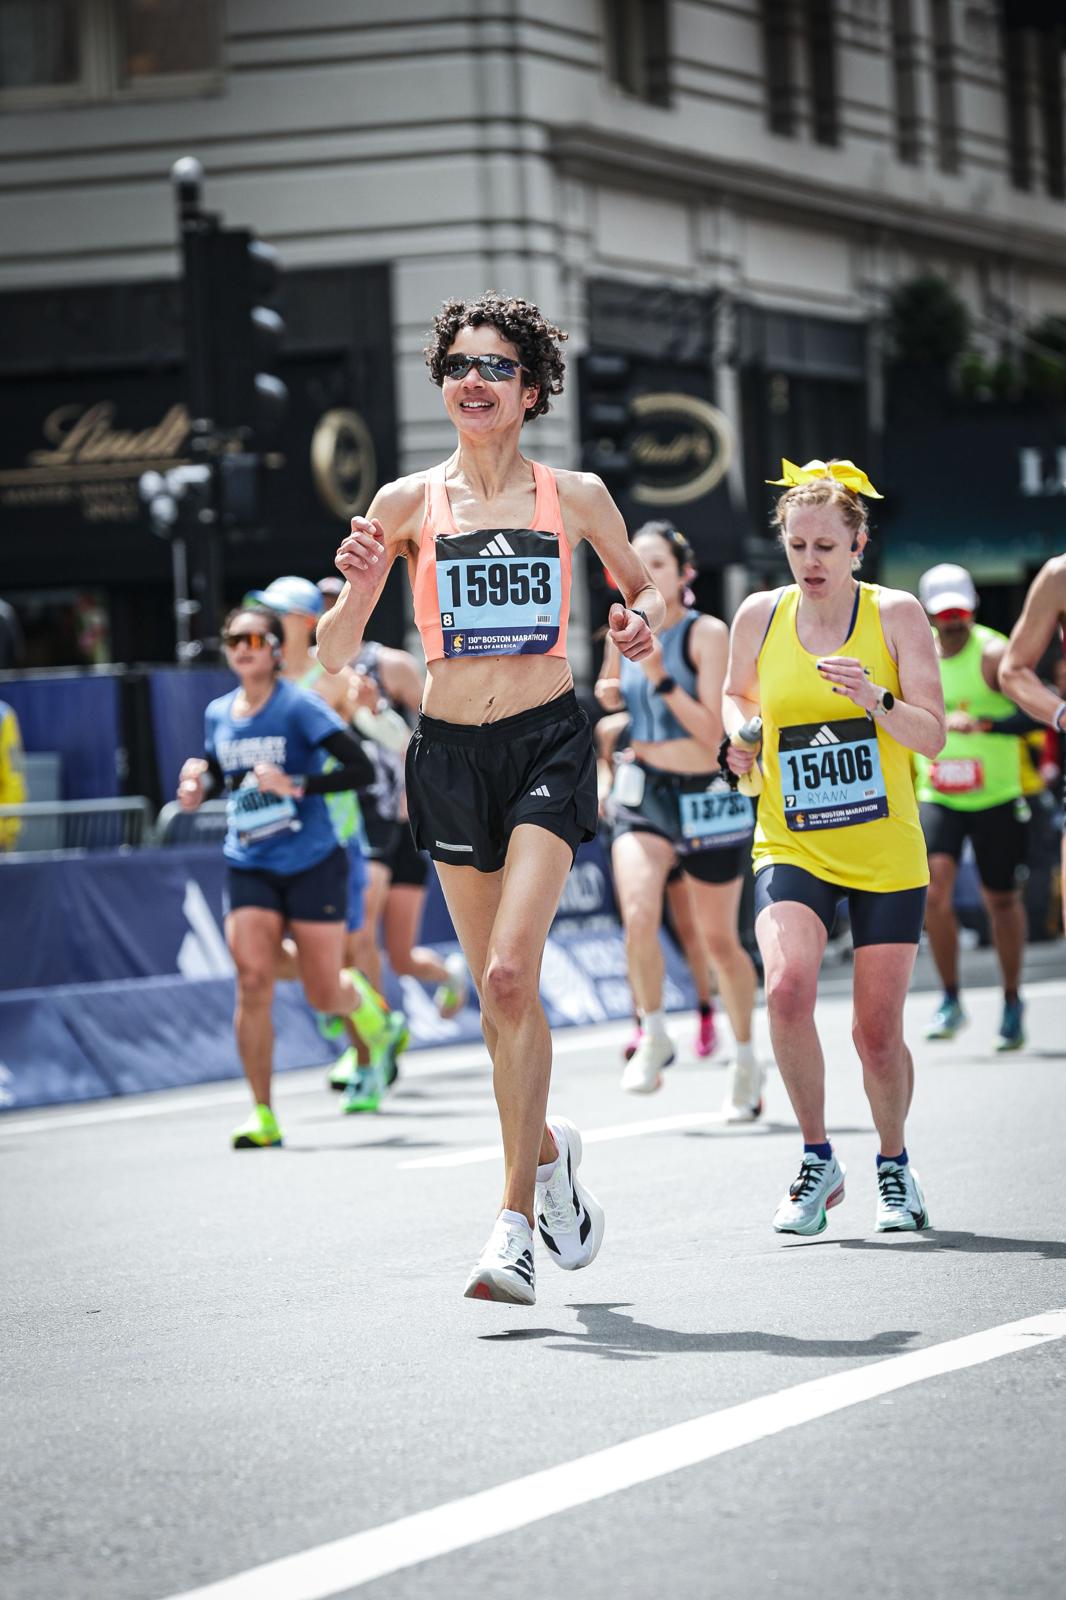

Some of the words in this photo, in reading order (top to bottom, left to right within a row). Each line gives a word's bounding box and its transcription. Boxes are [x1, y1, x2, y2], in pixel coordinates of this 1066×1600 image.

[447, 562, 552, 608] 15953
[442, 613, 453, 626] 8
[482, 635, 511, 643] BOSTON
[512, 633, 548, 642] MARATHON
[787, 744, 873, 791] 15406
[786, 796, 795, 807] 7
[821, 810, 845, 819] BOSTON
[845, 804, 878, 816] MARATHON
